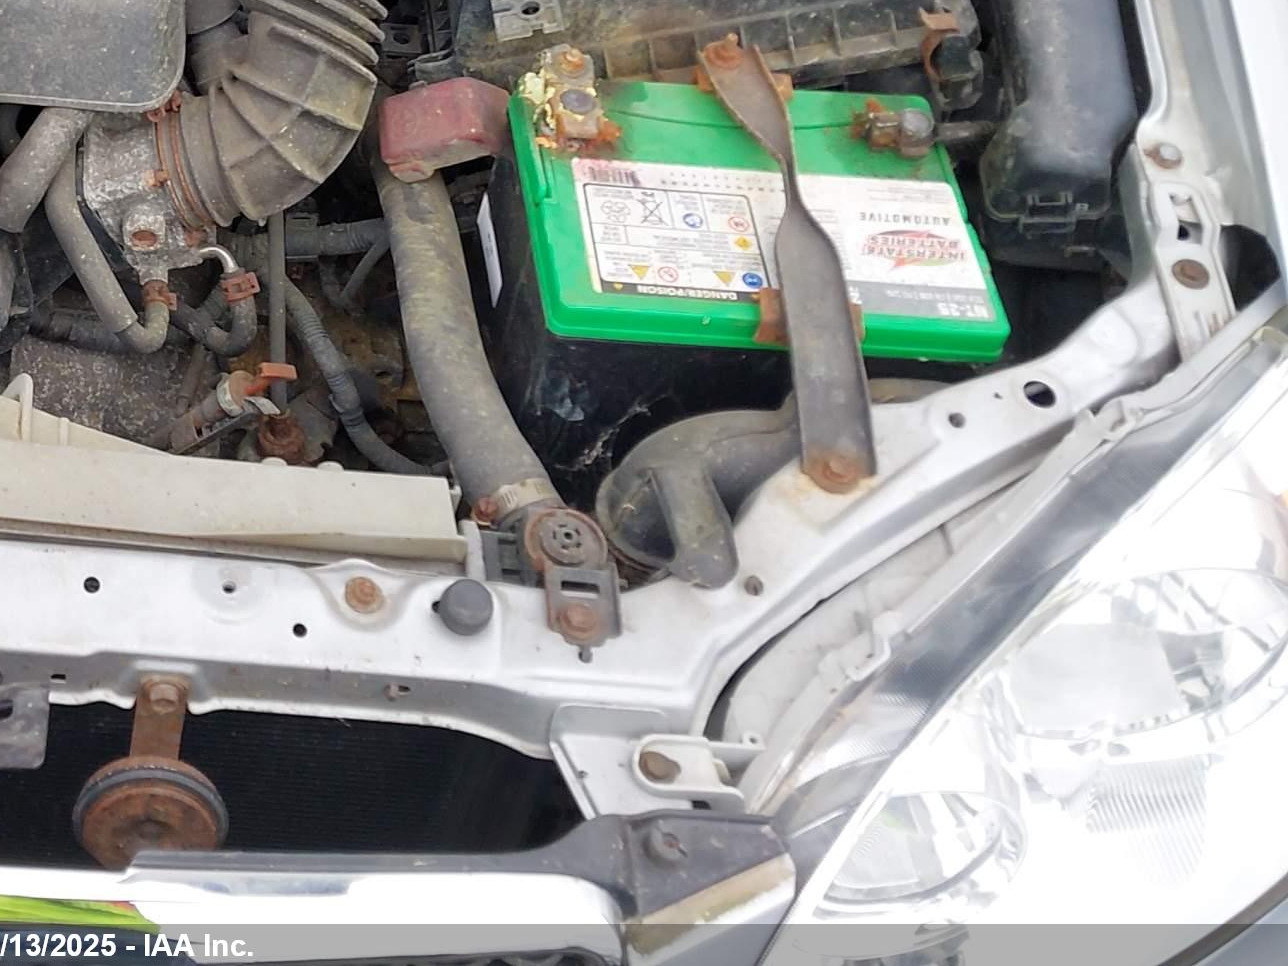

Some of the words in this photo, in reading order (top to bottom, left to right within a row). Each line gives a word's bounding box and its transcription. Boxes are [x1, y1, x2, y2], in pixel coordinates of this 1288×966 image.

[859, 211, 951, 226] AUTOMOTIVE
[869, 235, 960, 249] BATTERIES
[867, 245, 965, 260] INTERSTATE
[636, 284, 739, 301] DANGER/POISON
